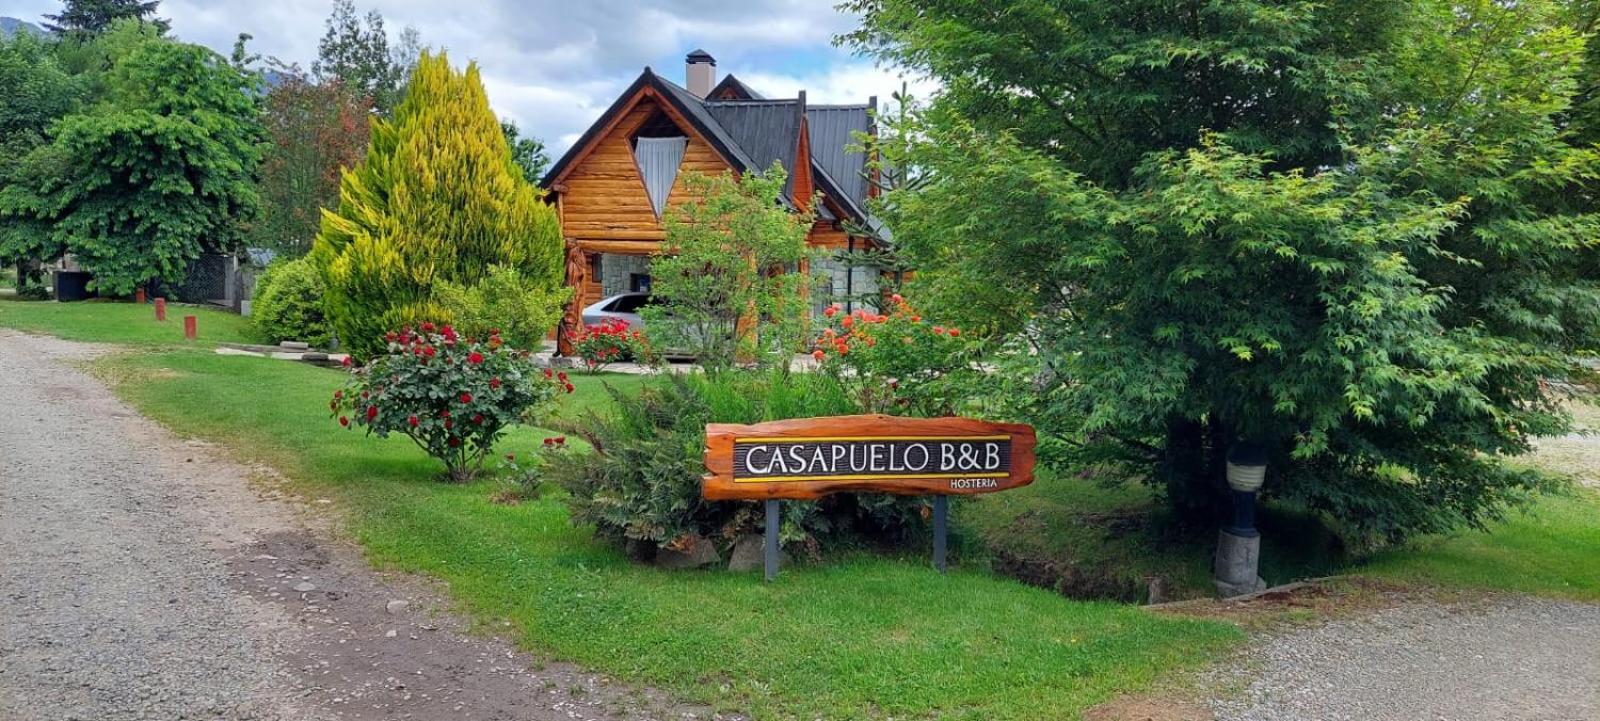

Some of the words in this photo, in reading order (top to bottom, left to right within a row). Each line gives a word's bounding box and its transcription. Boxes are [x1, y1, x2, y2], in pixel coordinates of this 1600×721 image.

[746, 443, 929, 473] CASAPUELO
[940, 443, 1000, 471] B&B
[951, 478, 997, 488] HOSTERIA
